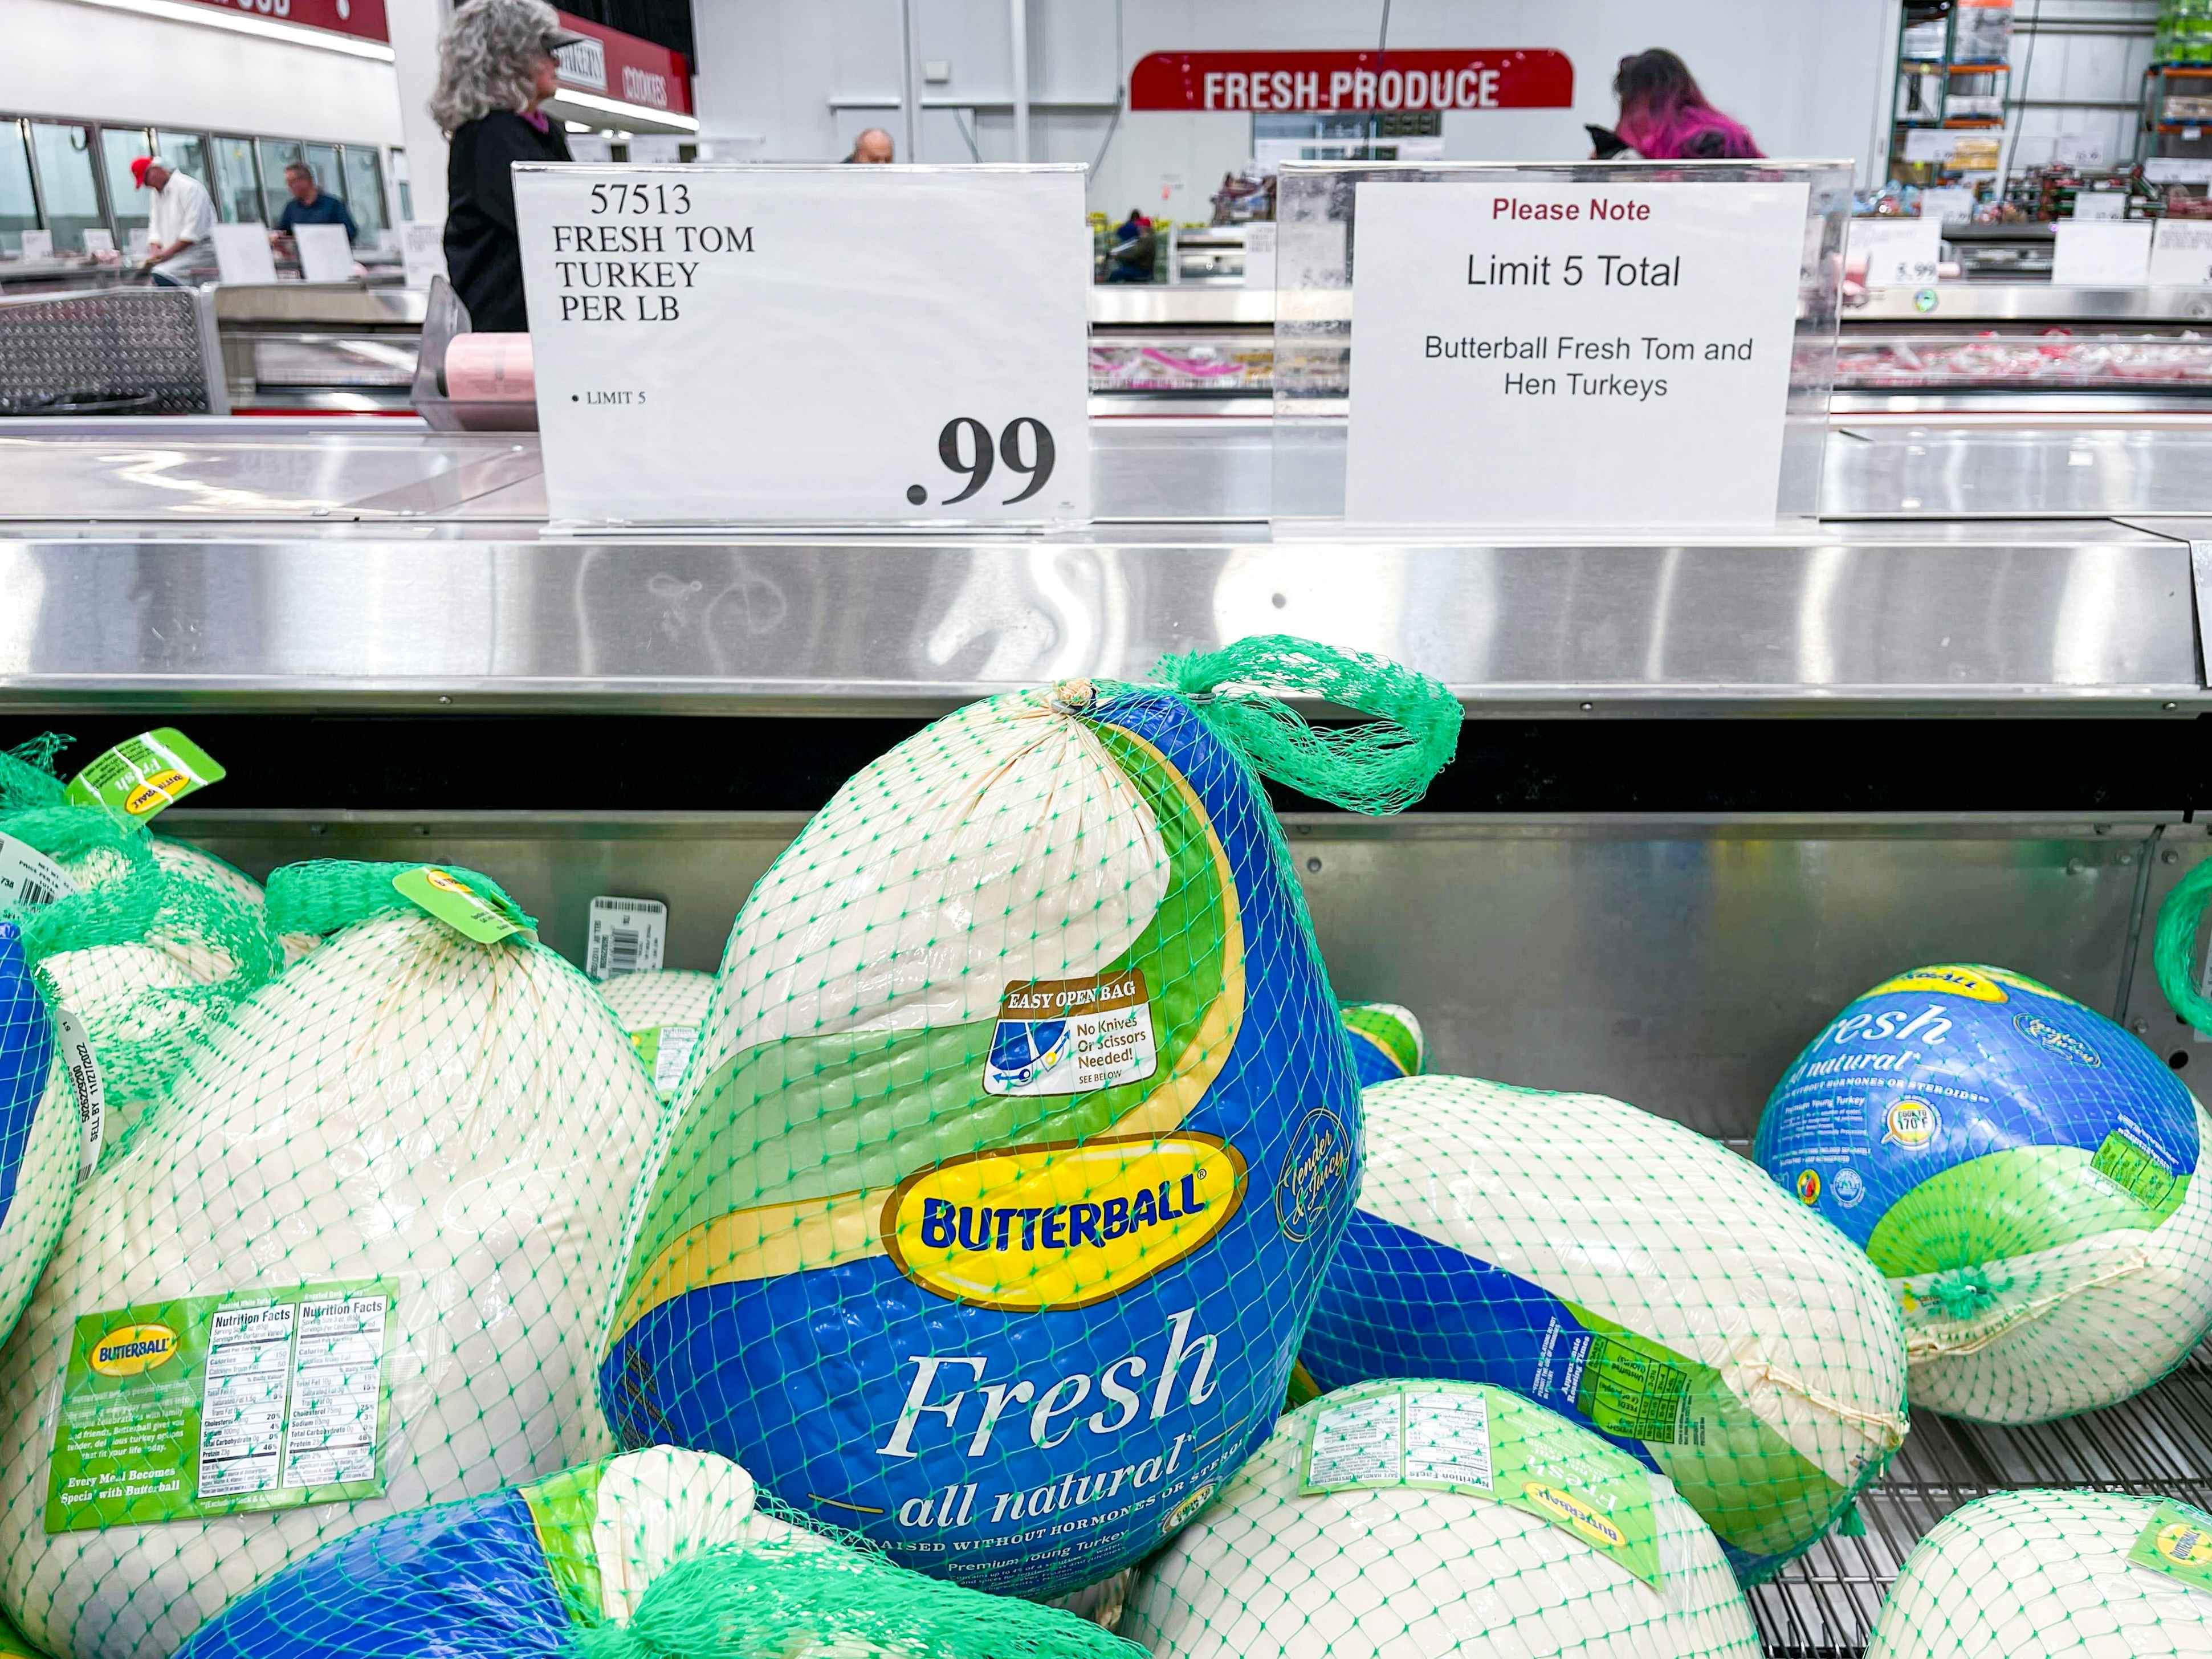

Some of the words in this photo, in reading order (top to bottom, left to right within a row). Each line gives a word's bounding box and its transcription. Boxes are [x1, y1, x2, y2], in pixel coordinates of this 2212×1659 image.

[1204, 72, 1318, 109] FRESH
[1330, 70, 1500, 108] PRODUCE
[591, 184, 691, 214] 57513
[1492, 199, 1579, 221] Please
[1590, 199, 1651, 221] Note
[553, 226, 666, 252] FRESH
[676, 226, 755, 252] TOM
[556, 262, 699, 287] TURKEY
[1467, 255, 1550, 286] Limit
[1563, 255, 1583, 286] 5
[1598, 256, 1680, 287] Total
[560, 296, 626, 321] PER
[638, 296, 679, 321] LB
[1425, 336, 1546, 359] Butterball
[1557, 337, 1630, 360] Fresh
[1642, 338, 1694, 360] Tom
[1705, 339, 1753, 361] and
[586, 392, 633, 405] LIMIT
[638, 392, 646, 405] 5
[1505, 373, 1555, 396] Hen
[1567, 374, 1667, 401] Turkeys
[906, 417, 1056, 506] .99
[1008, 993, 1053, 1009] EASY
[1056, 989, 1097, 1007] OPEN
[1100, 980, 1136, 1001] BAG
[1077, 1024, 1095, 1036] No
[1098, 1016, 1137, 1033] Knives
[1812, 1003, 1953, 1053] resh
[1078, 1040, 1092, 1053] Or
[1078, 1048, 1133, 1069] Needed!
[76, 1042, 97, 1095] 11/27/2022
[1079, 1075, 1093, 1084] SEE
[1887, 1078, 1904, 1089] OR
[92, 1102, 99, 1116] BY
[1836, 1095, 1865, 1106] Turkey
[90, 1117, 99, 1142] SELL
[1284, 1130, 1332, 1196] Tender
[920, 1174, 1205, 1251] BUTTERBALL
[216, 1313, 259, 1327] Nutrition
[263, 1310, 290, 1322] Facts
[354, 1301, 382, 1313] Facts
[99, 1338, 170, 1362] BUTTERBALL
[1567, 1366, 1584, 1404] Roasting
[1576, 1335, 1590, 1364] Times
[877, 1307, 1219, 1459] Fresh
[68, 1477, 97, 1488] Every
[128, 1468, 176, 1481] Becomes
[1526, 1453, 1618, 1513] Fresh
[99, 1489, 122, 1499] with
[898, 1481, 977, 1528] all
[953, 1527, 1046, 1551] WITHOUT
[1050, 1498, 1156, 1536] HORMONES
[1162, 1483, 1184, 1499] OR
[948, 1558, 1019, 1571] Premium
[1076, 1529, 1129, 1551] Turkey
